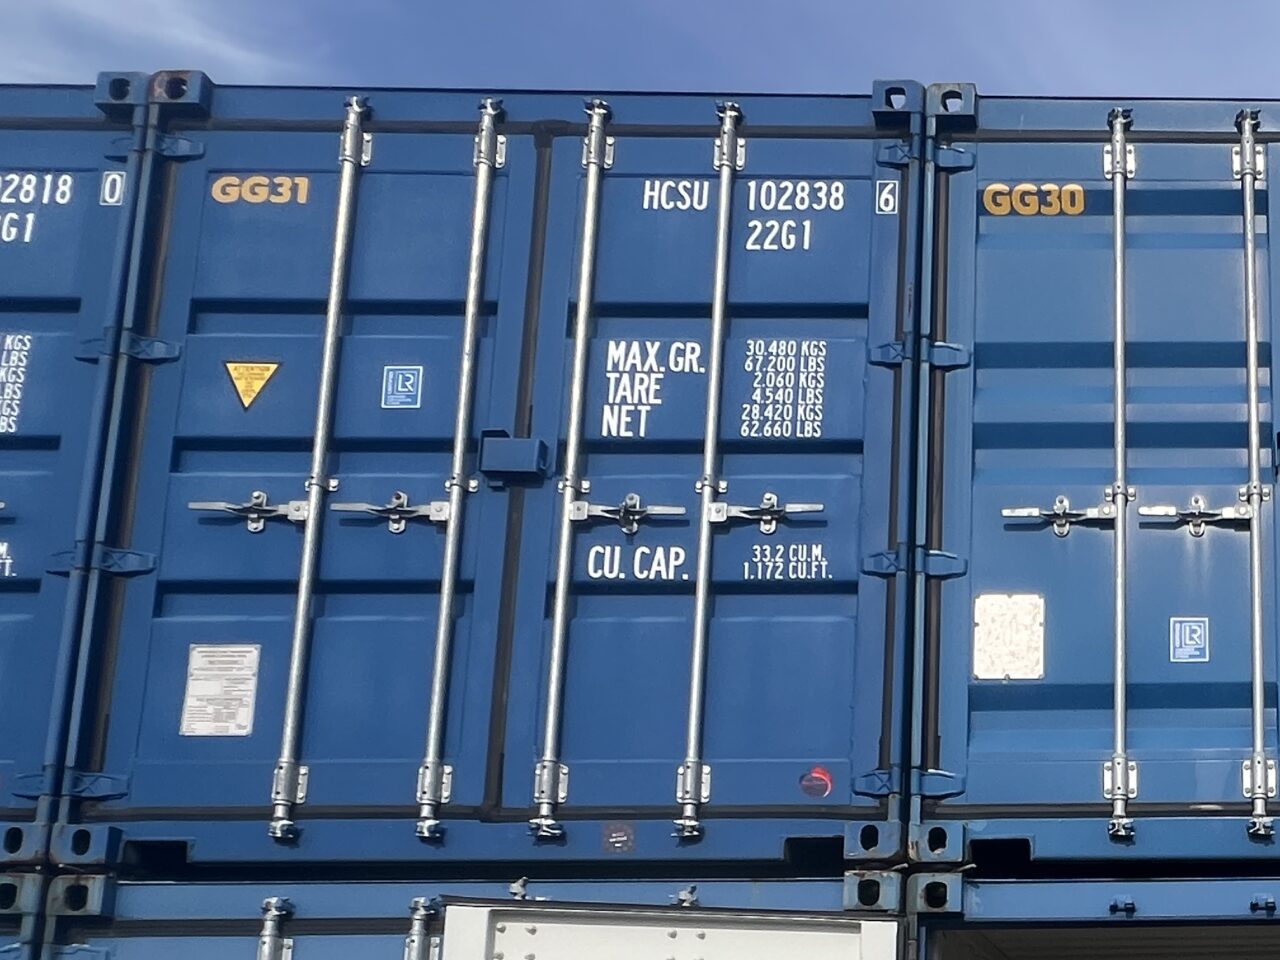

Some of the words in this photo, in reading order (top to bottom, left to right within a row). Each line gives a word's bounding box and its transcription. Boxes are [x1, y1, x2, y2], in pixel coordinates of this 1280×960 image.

[104, 174, 122, 204] 0
[213, 176, 309, 203] GG31
[644, 181, 709, 210] HCSU
[748, 181, 843, 210] 102838
[879, 185, 894, 213] 6
[984, 184, 1084, 215] GG30
[746, 220, 810, 249] 22G1
[5, 335, 31, 350] KGS
[746, 340, 796, 357] 30.480
[801, 341, 826, 356] KGS
[1, 351, 27, 366] LBS
[745, 356, 795, 373] 67.200
[800, 357, 824, 373] LBS
[607, 373, 663, 404] TARE
[754, 372, 794, 389] 2.060
[799, 372, 824, 389] KGS
[752, 388, 793, 405] 4.540
[798, 388, 822, 405] LBS
[602, 405, 650, 436] NET
[742, 404, 792, 420] 28.420
[798, 405, 822, 420] KGS
[741, 421, 791, 436] 62.660
[797, 421, 821, 437] LBS
[753, 545, 784, 562] 33.2
[790, 545, 826, 562] CU.M.
[589, 546, 625, 578] CU.
[634, 547, 688, 579] CAP.
[789, 561, 832, 578] CU.FT.
